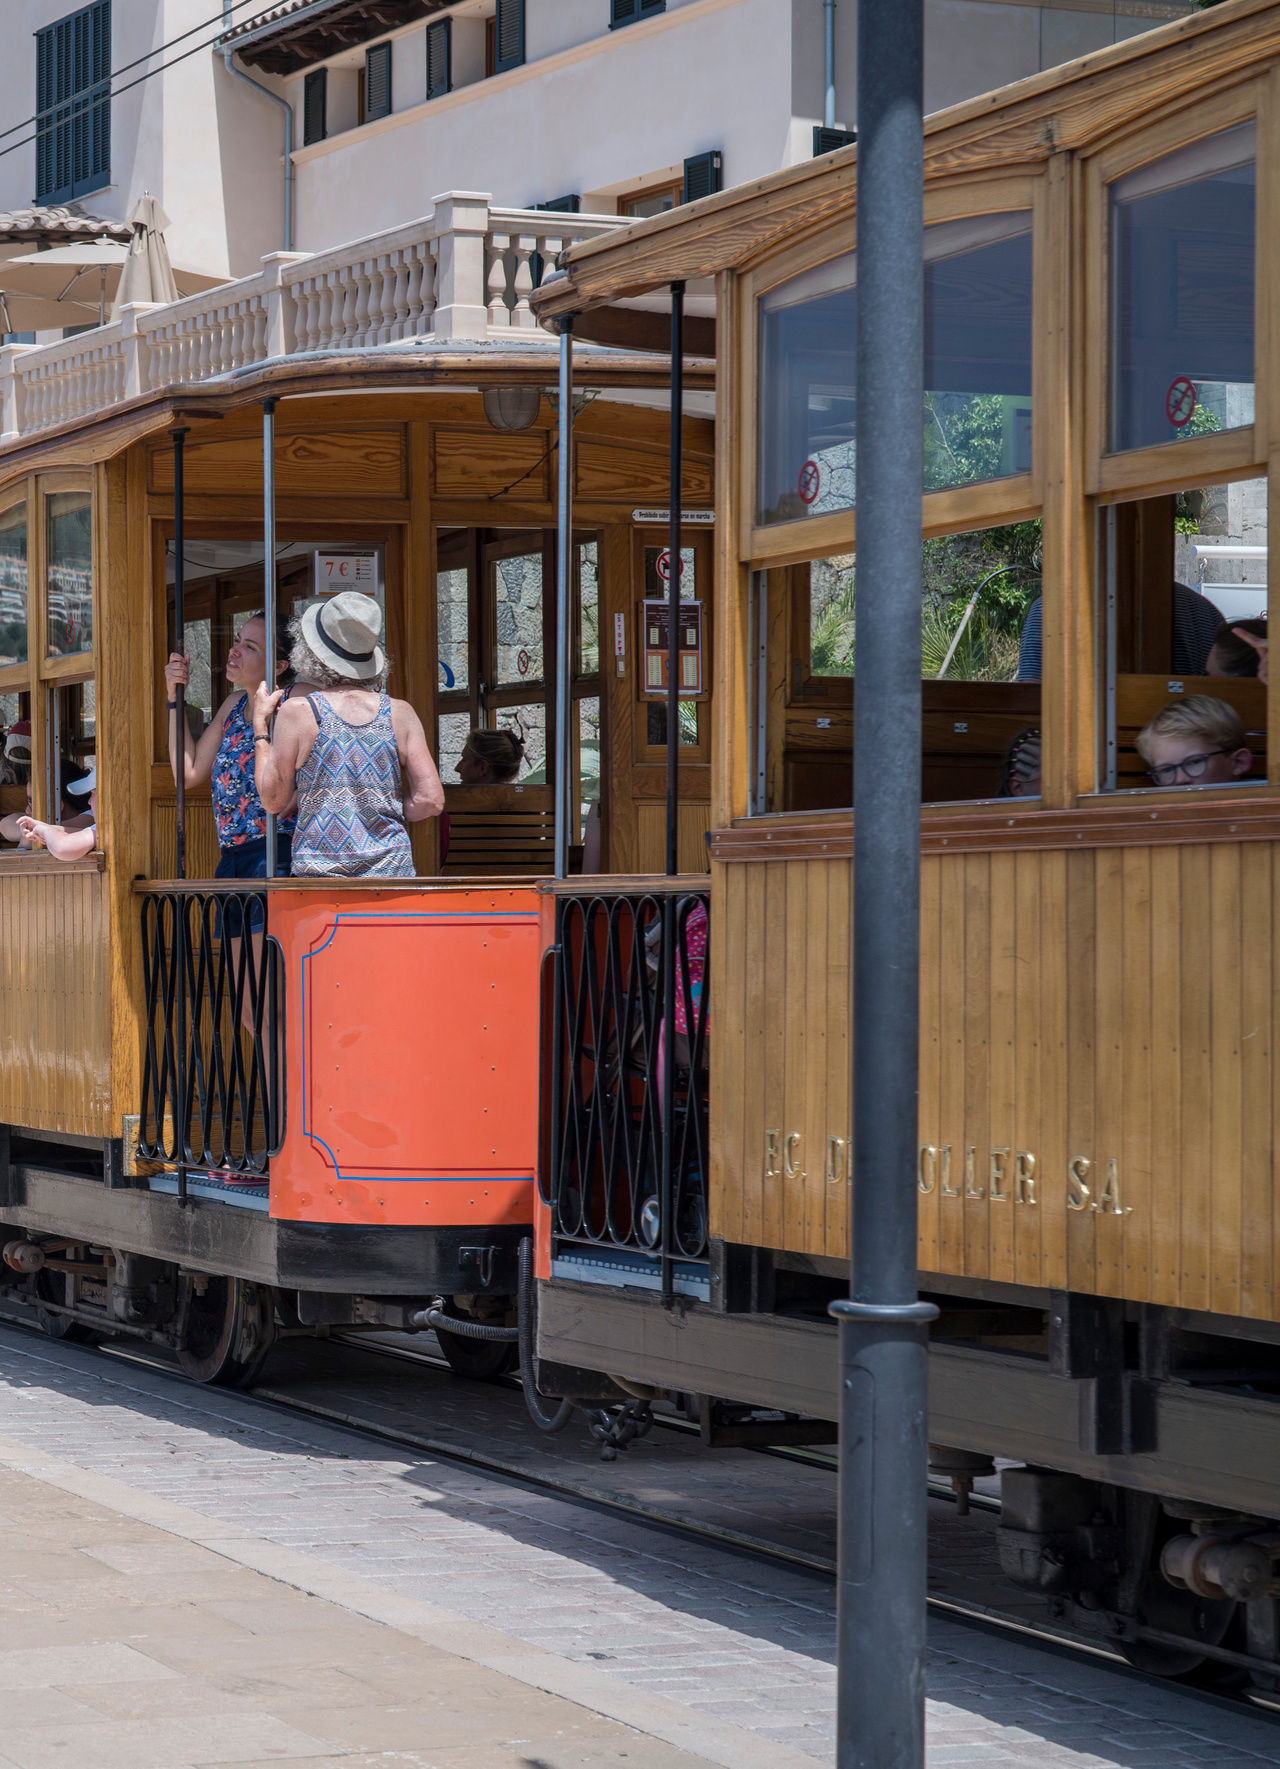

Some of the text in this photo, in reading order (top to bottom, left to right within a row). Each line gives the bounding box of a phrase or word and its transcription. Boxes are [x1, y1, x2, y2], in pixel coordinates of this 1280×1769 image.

[325, 561, 334, 576] 7
[339, 561, 349, 577] €
[917, 1142, 1037, 1205] OLLER
[1067, 1154, 1133, 1216] S.A.
